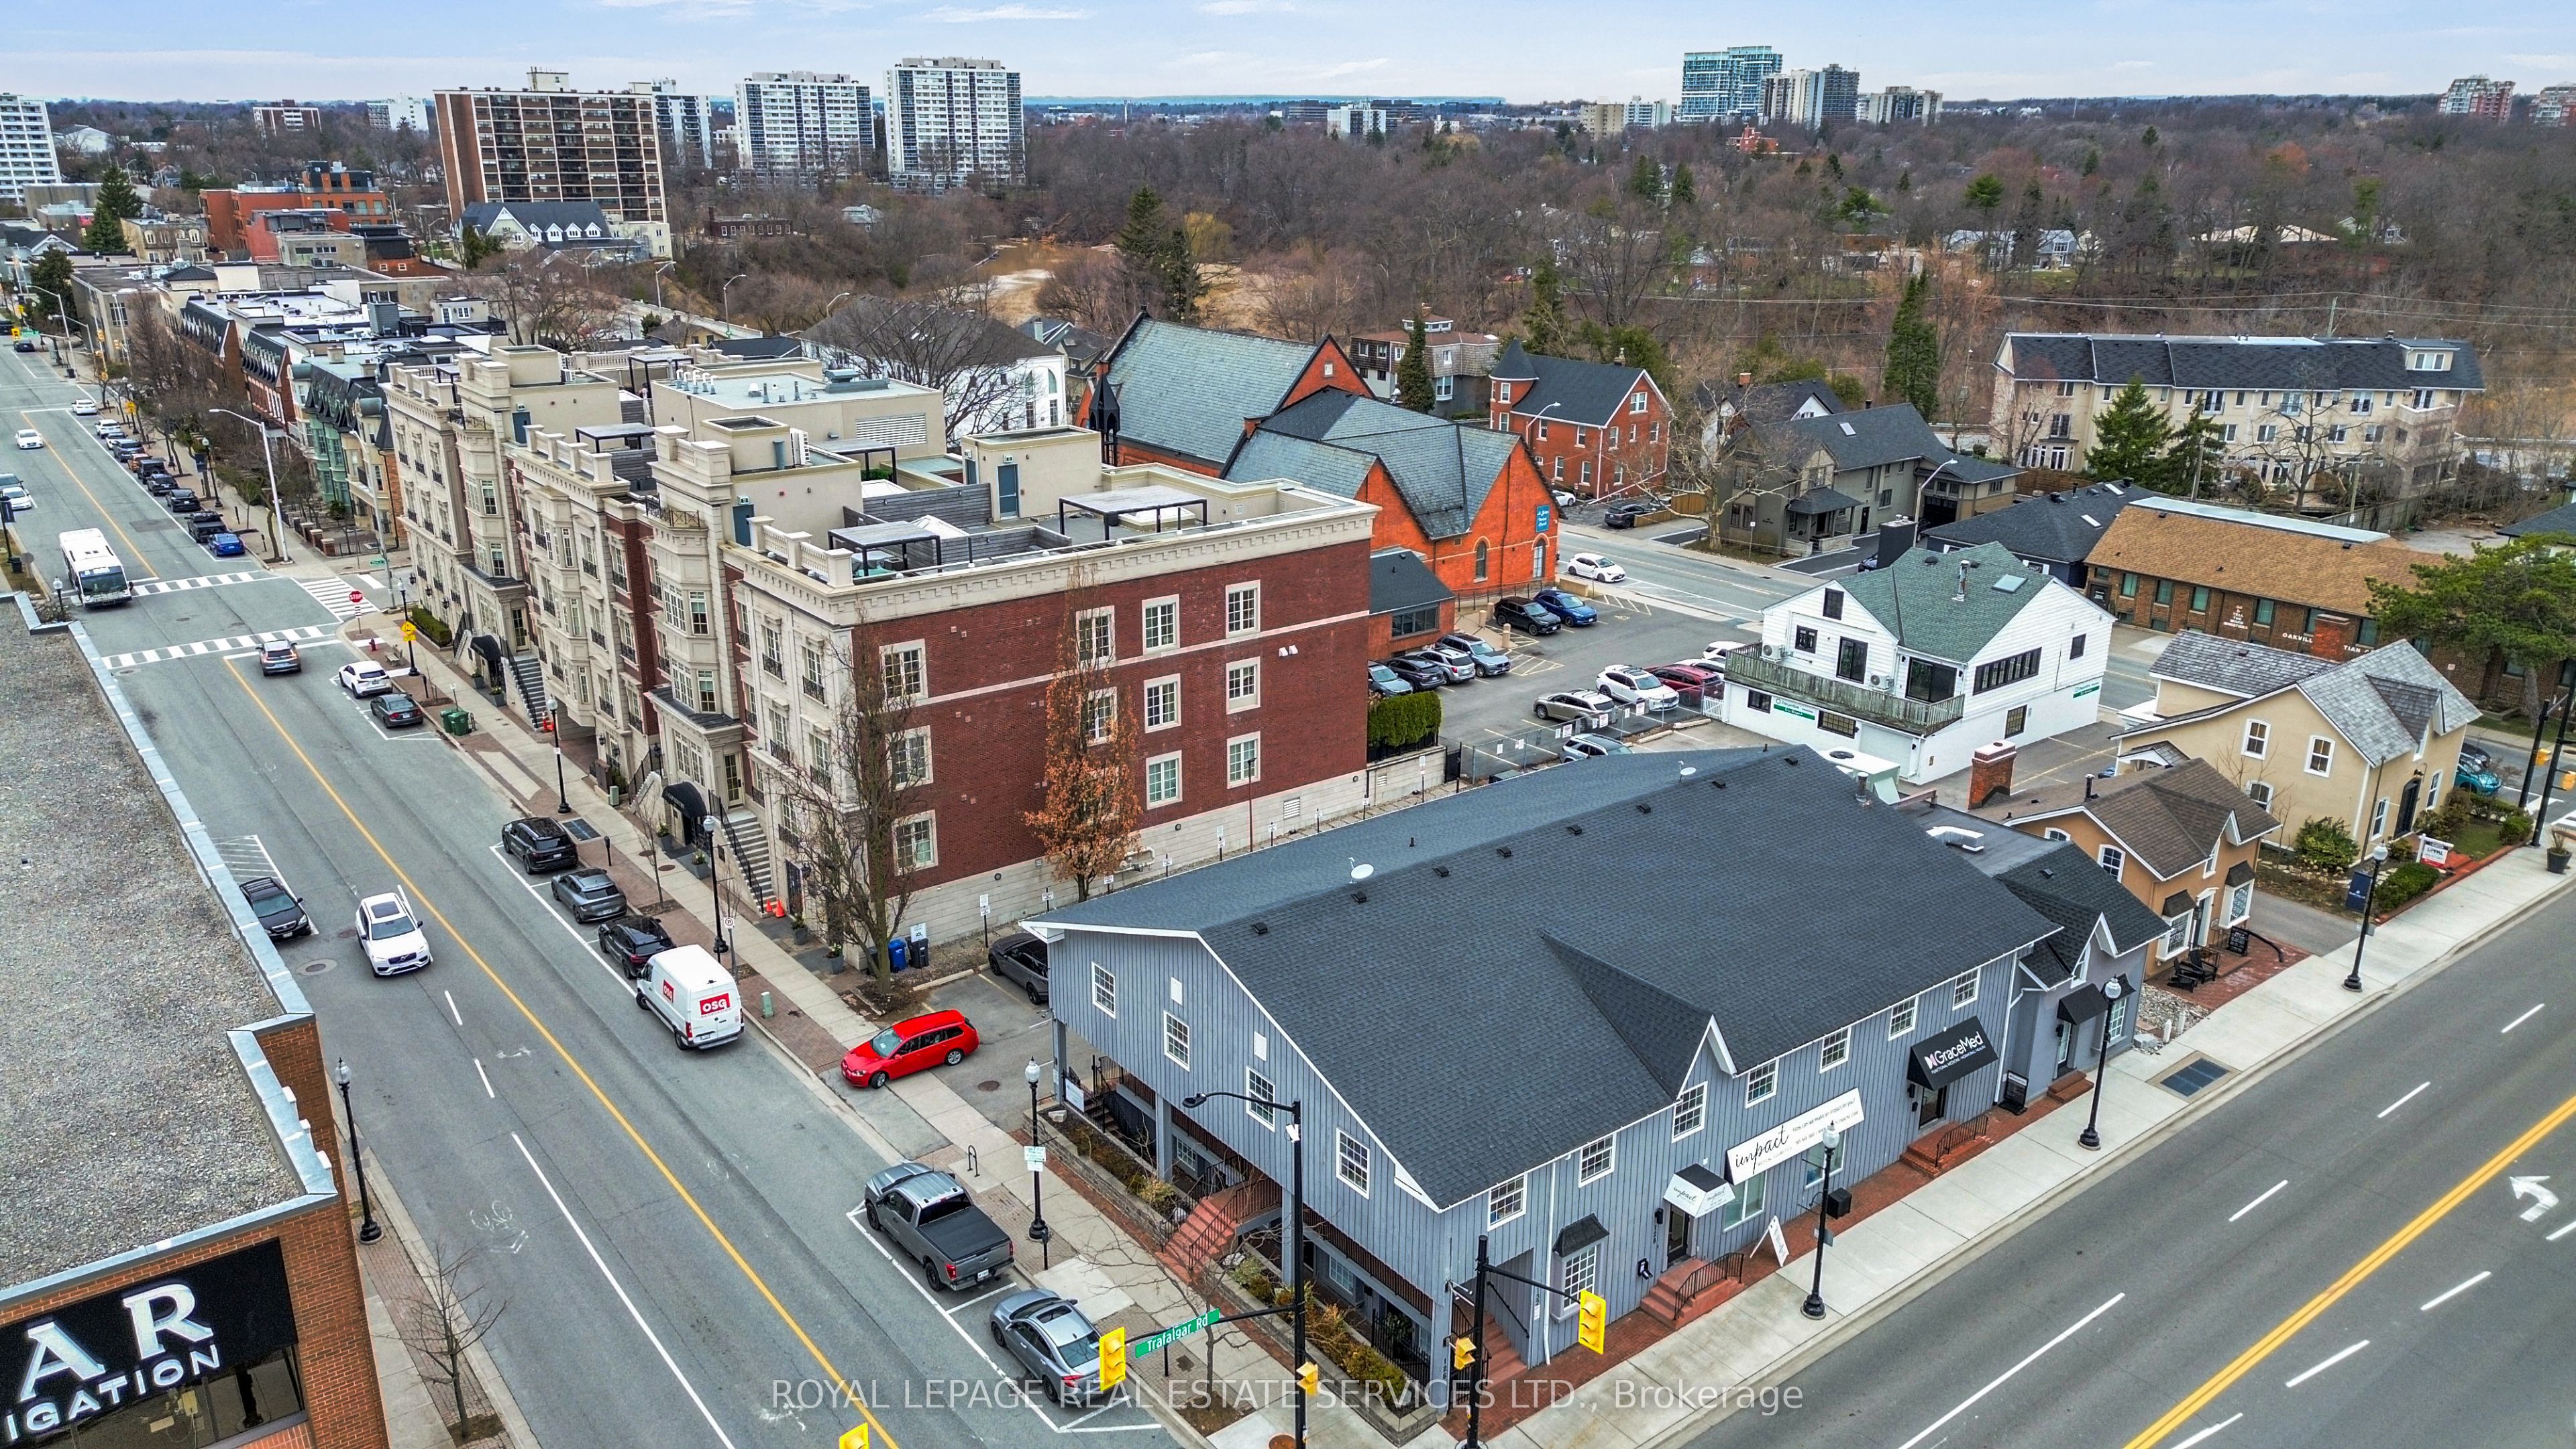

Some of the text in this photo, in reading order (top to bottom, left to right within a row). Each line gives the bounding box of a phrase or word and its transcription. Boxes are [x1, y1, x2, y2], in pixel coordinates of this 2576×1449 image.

[2282, 633, 2313, 643] OAKVILL
[663, 985, 673, 1000] OSG
[702, 998, 727, 1012] OSG
[1935, 1032, 1984, 1064] GraceMed
[1735, 1125, 1789, 1175] impact
[1673, 1186, 1697, 1202] impact
[1147, 1313, 1208, 1352] Trafalgar Rd
